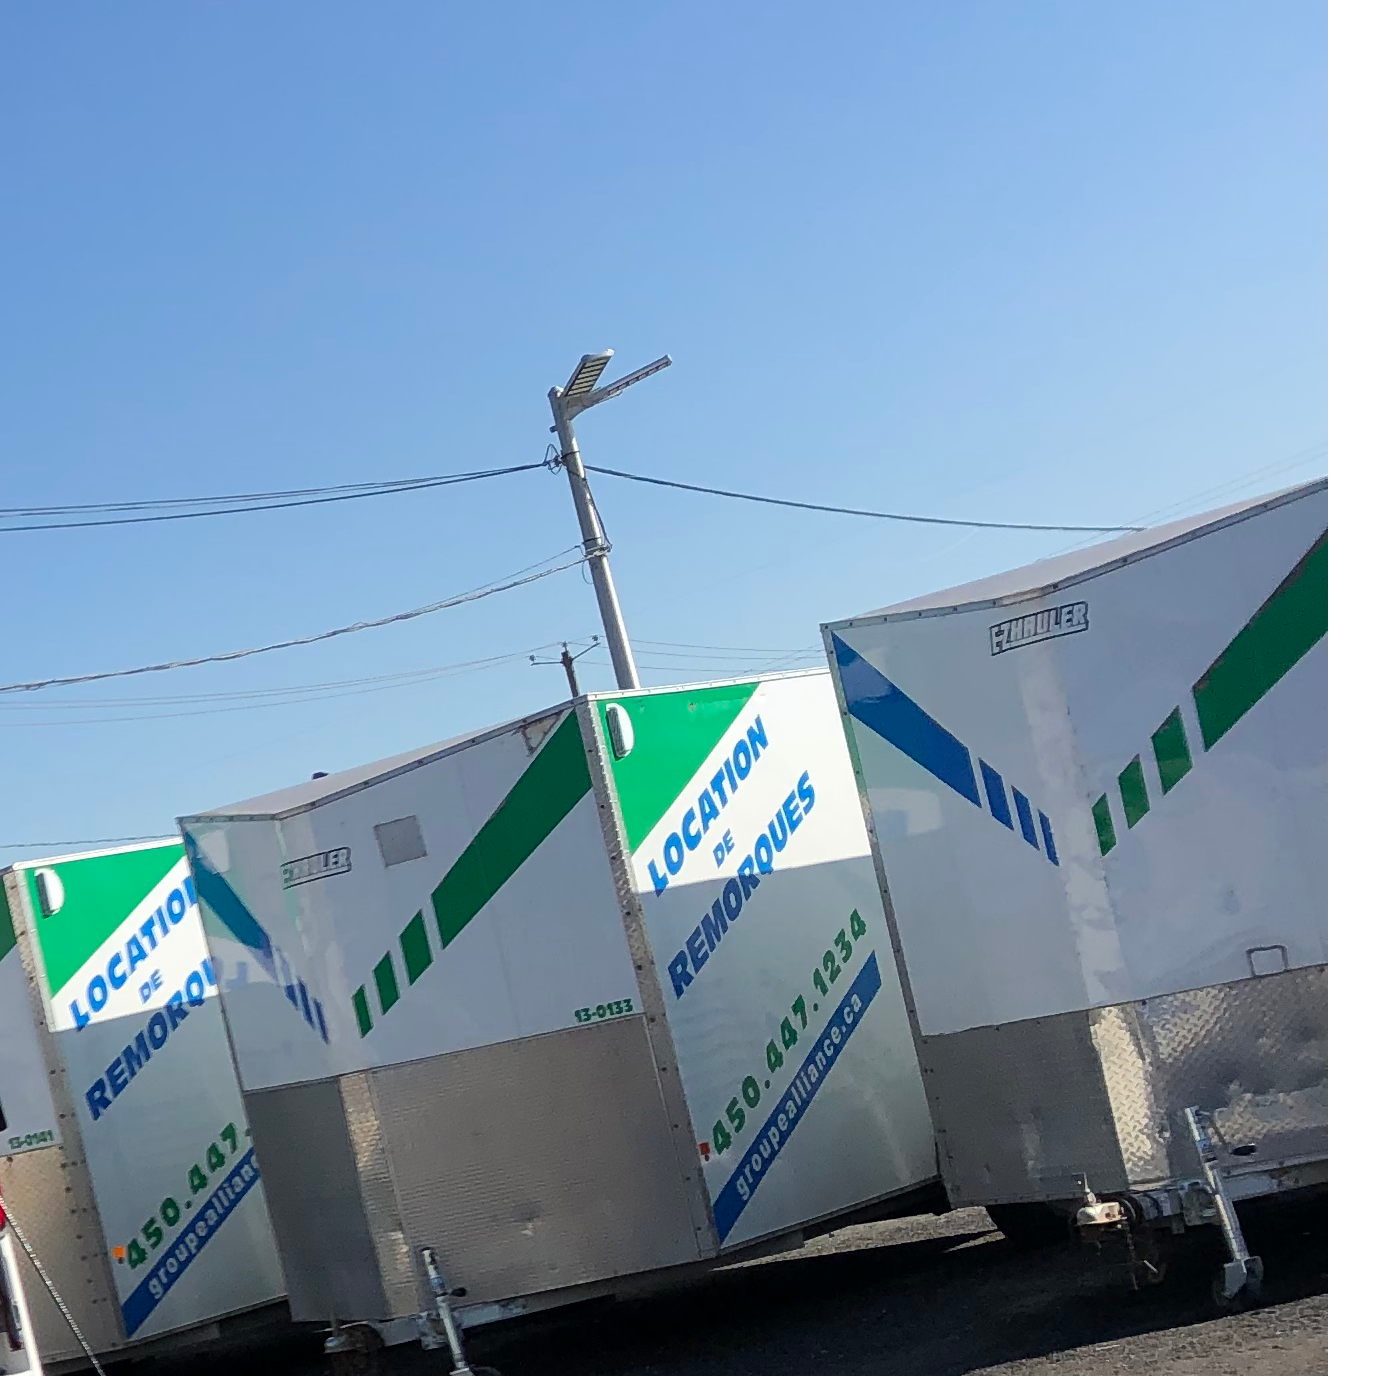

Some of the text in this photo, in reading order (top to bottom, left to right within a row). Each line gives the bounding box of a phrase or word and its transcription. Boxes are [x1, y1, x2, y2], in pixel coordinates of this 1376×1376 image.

[647, 714, 769, 897] LOCATION
[667, 770, 816, 1000] REMORQUES
[712, 828, 736, 868] DE
[138, 969, 164, 1004] DE
[574, 998, 634, 1023] 13-0133
[712, 908, 867, 1155] 450.447.1234
[736, 993, 862, 1201] groupealliance.ca
